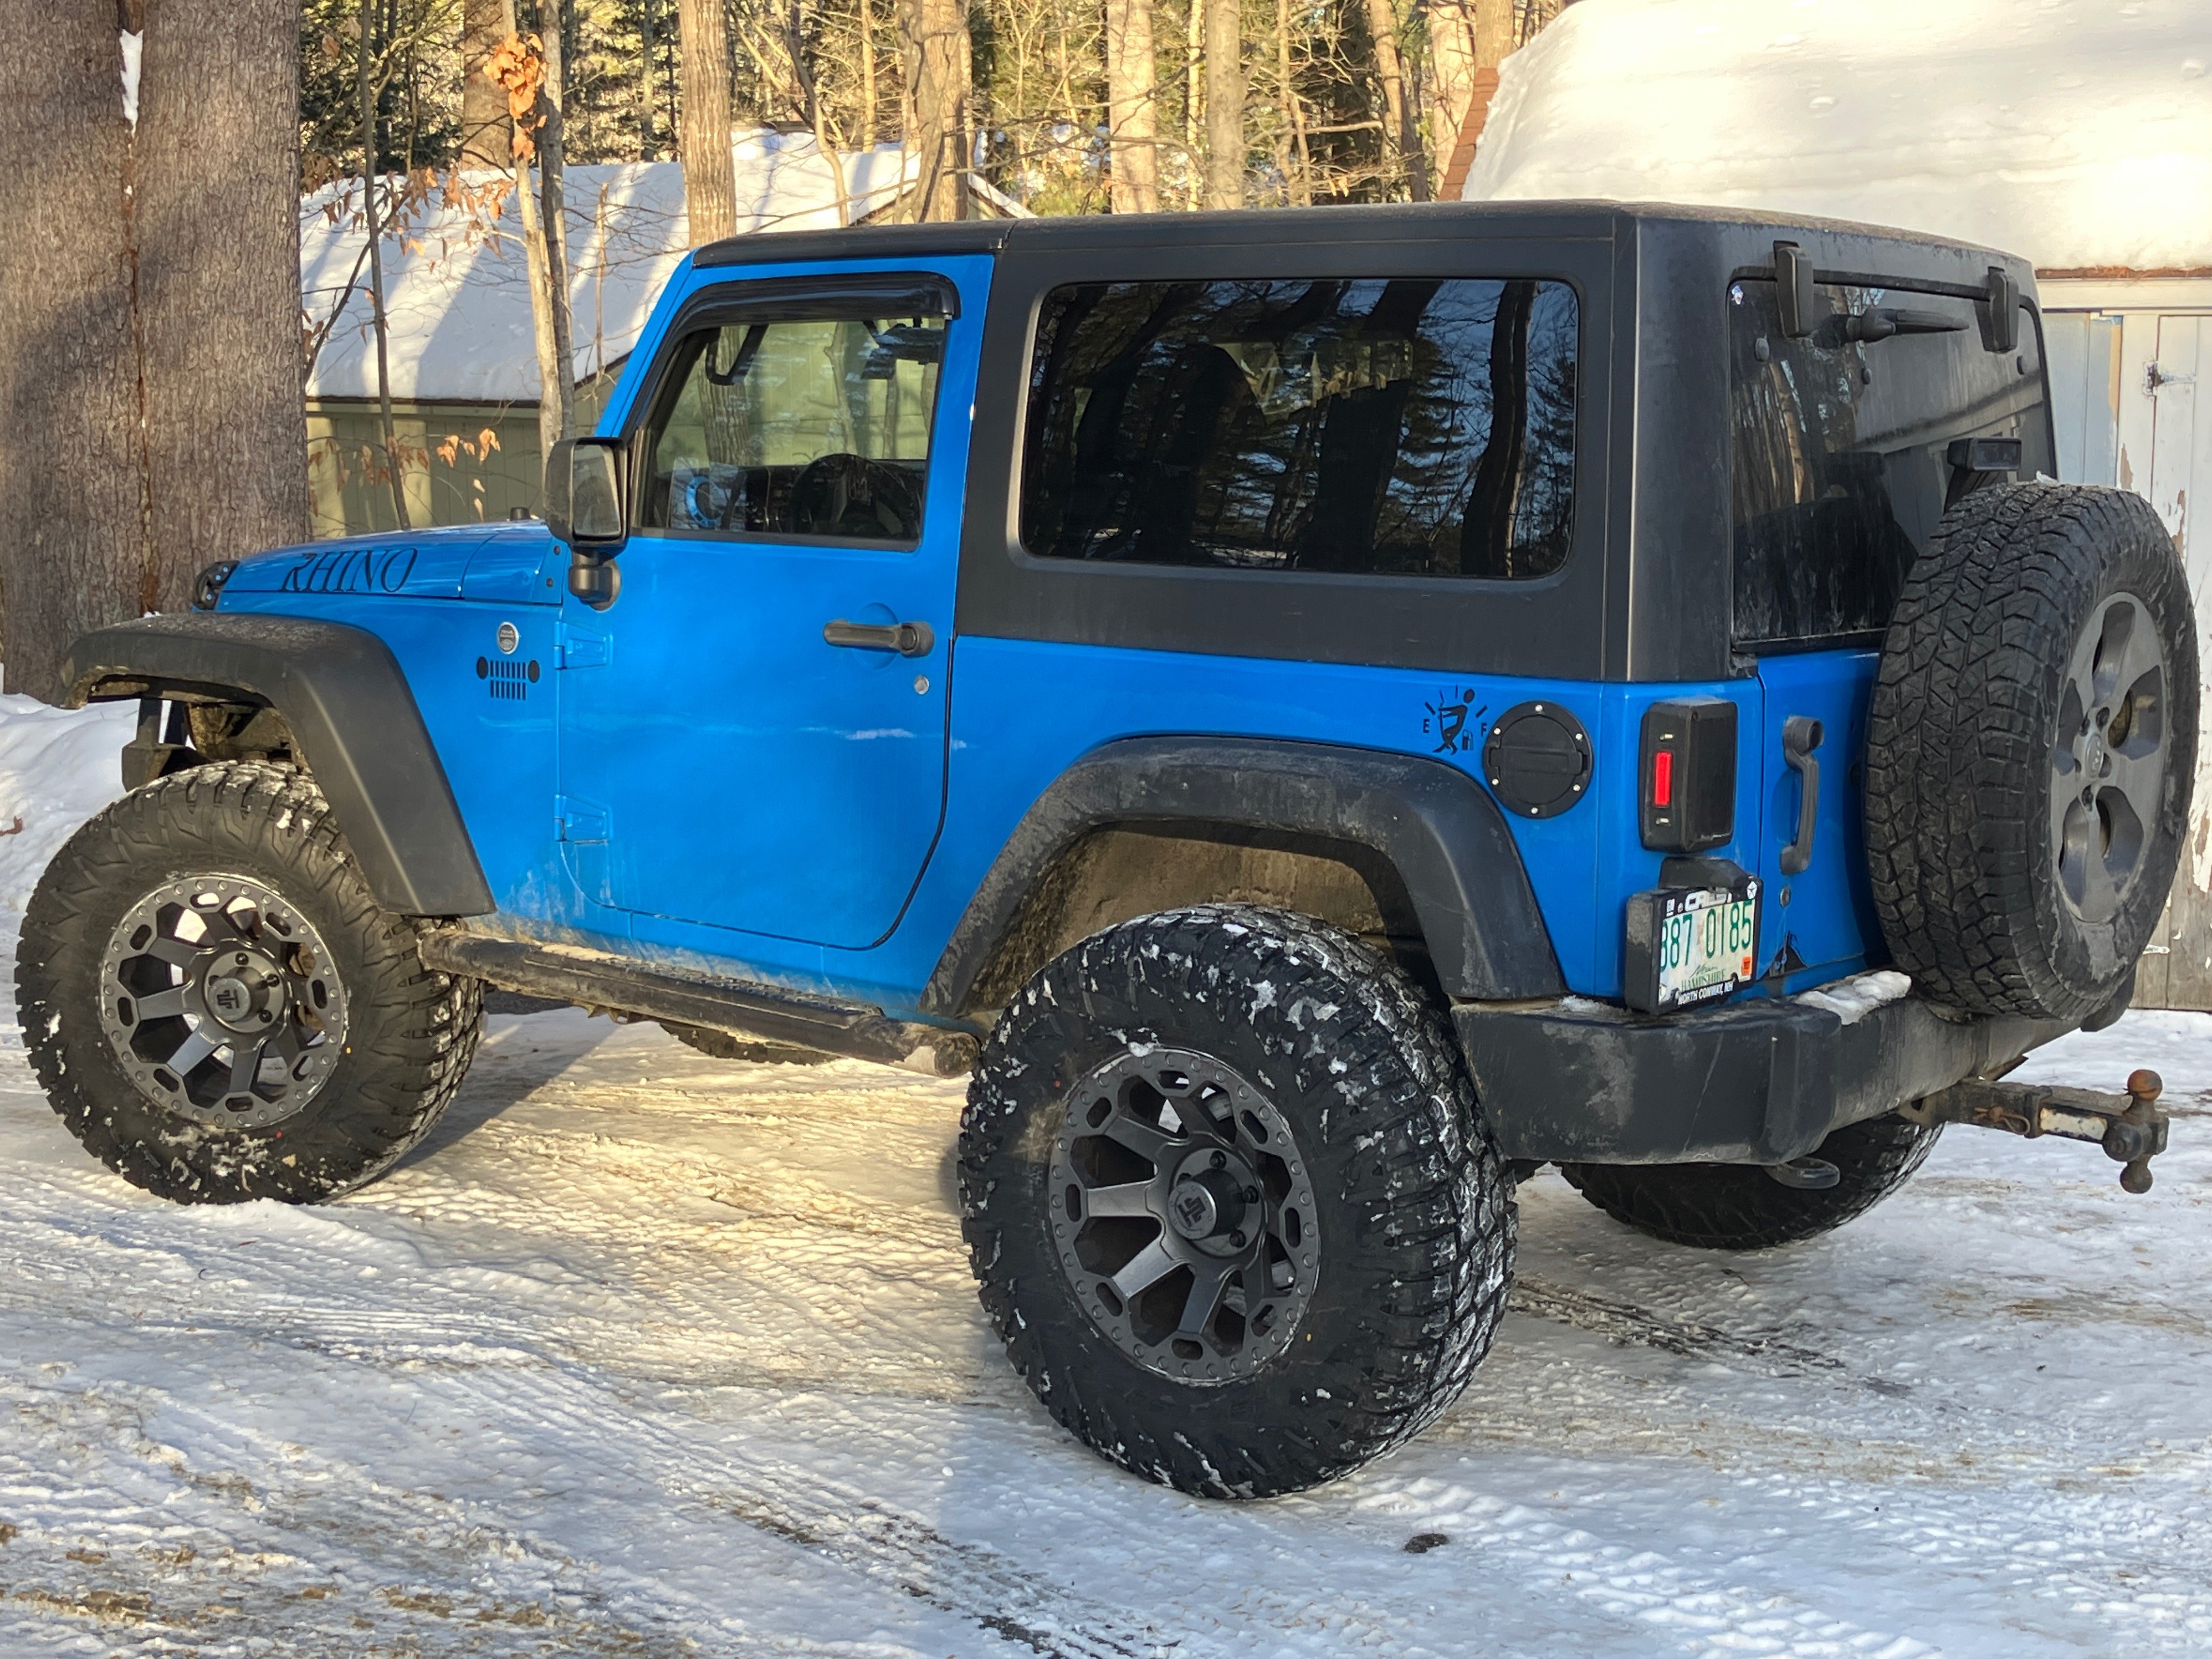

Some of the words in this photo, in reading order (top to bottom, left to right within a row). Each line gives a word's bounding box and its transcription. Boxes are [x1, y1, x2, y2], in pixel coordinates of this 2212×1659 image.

[278, 547, 418, 593] RHINO
[1423, 718, 1430, 733] E
[1481, 722, 1487, 737] F
[1706, 898, 1753, 959] 0185
[1681, 968, 1726, 993] HAMPSHIRE
